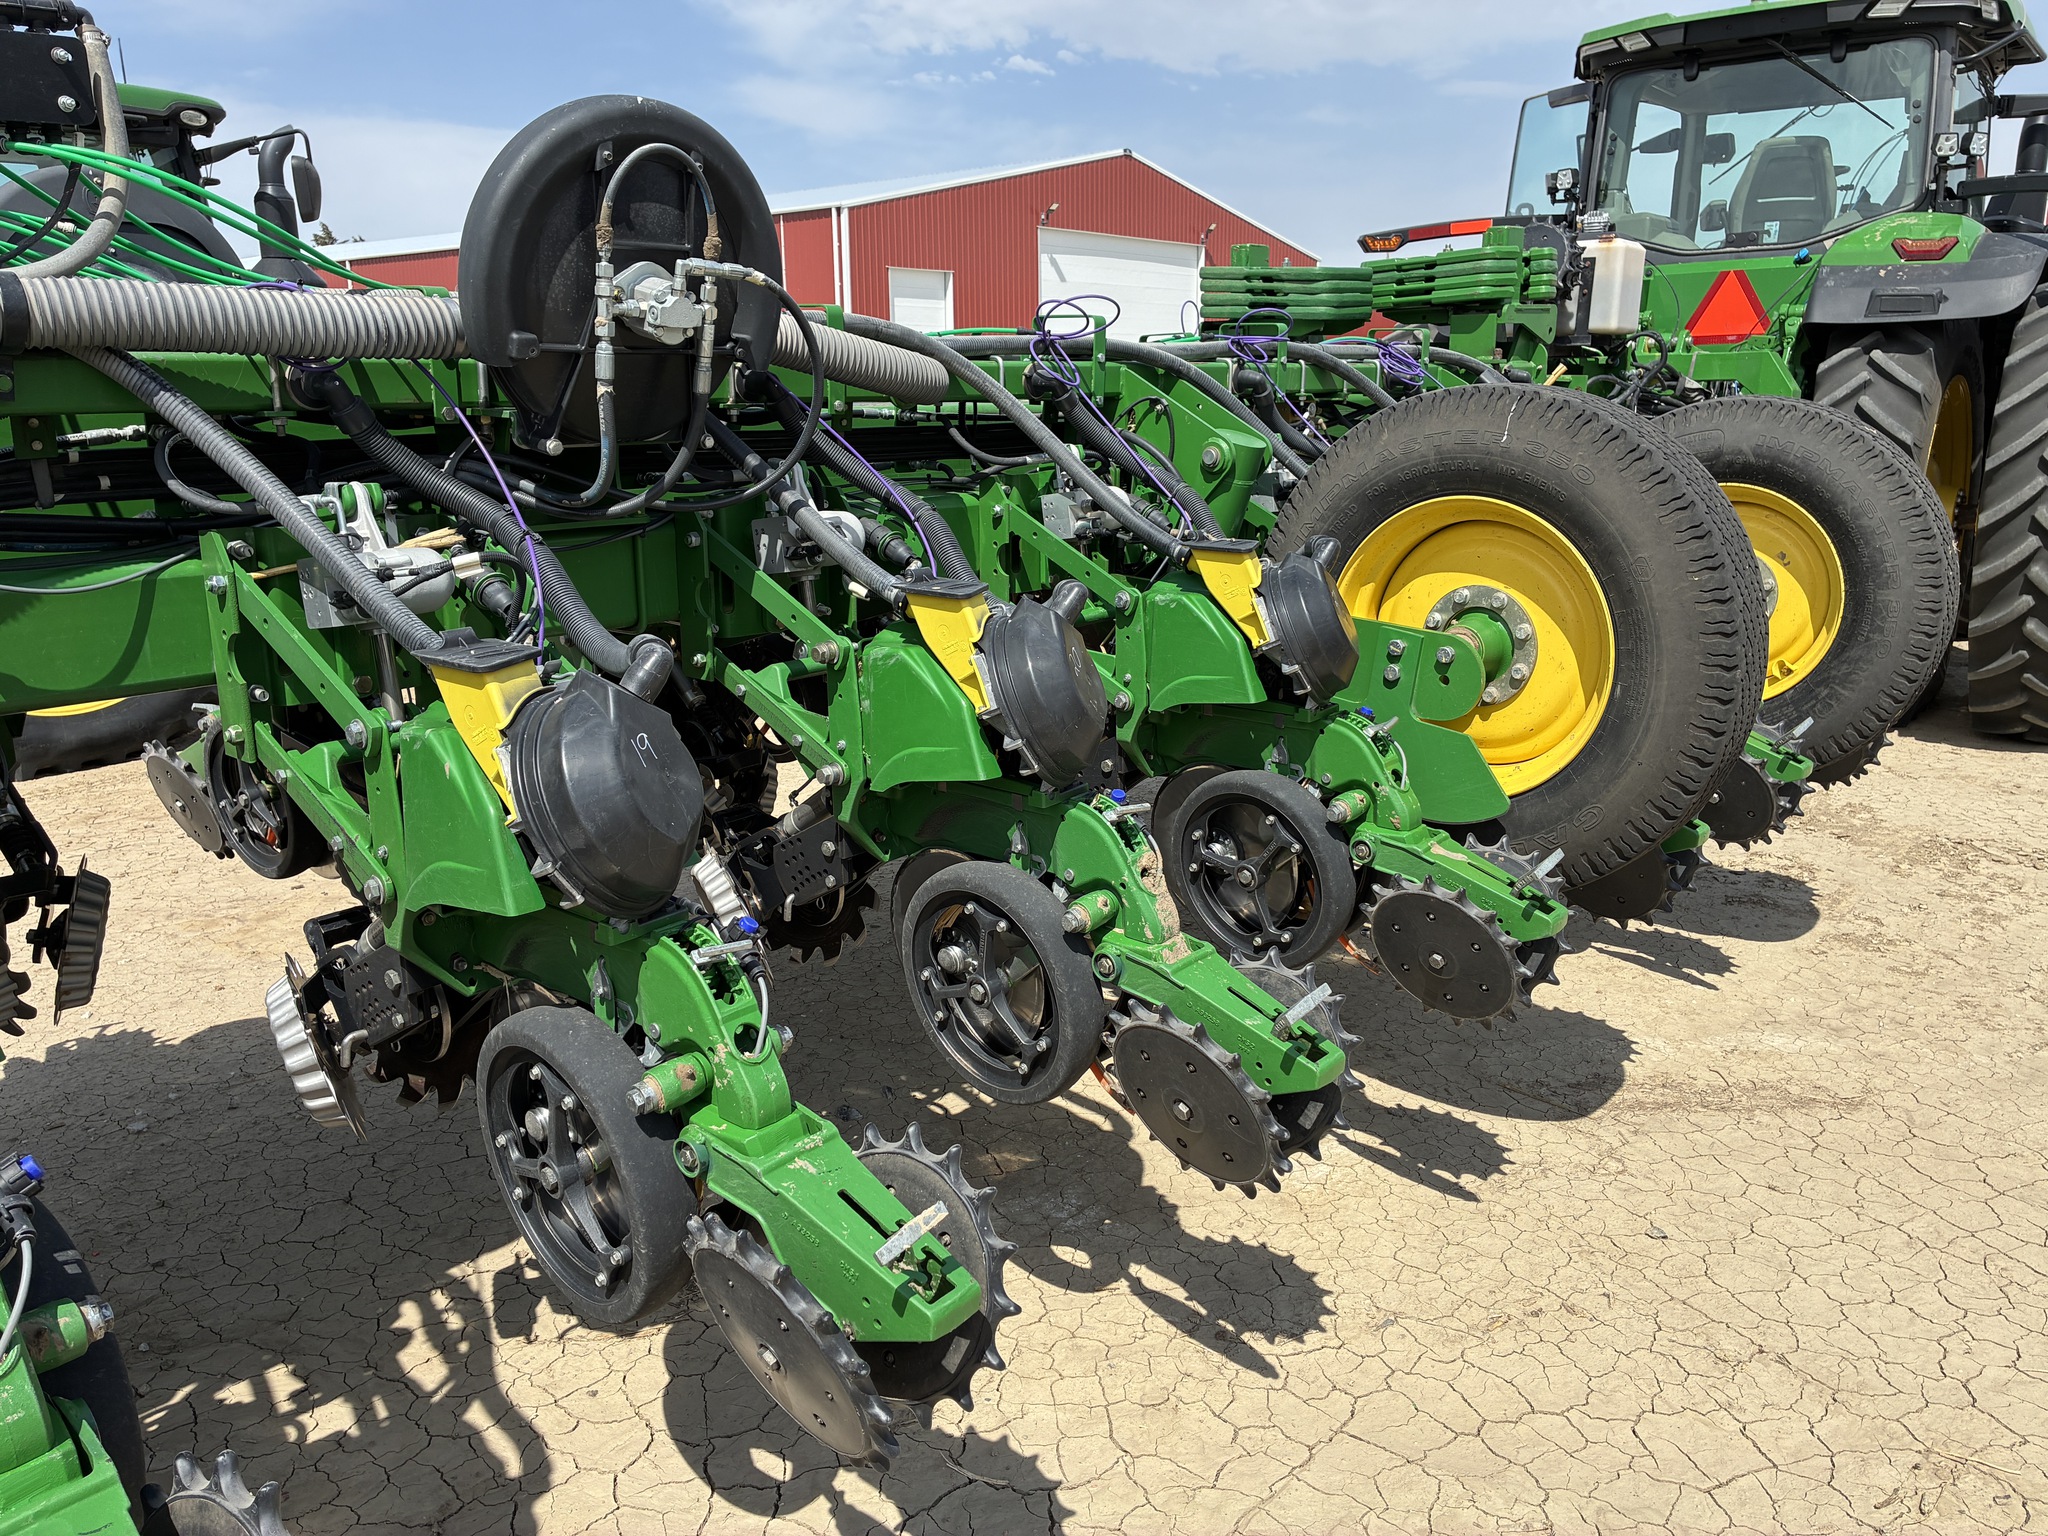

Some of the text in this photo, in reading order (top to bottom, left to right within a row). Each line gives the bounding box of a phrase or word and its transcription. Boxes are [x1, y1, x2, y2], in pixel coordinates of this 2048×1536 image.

[1523, 440, 1595, 486] 350
[1328, 460, 1567, 535] TREAD FOR AGRICULTURAL IMPLEMENTS
[630, 732, 658, 768] 19
